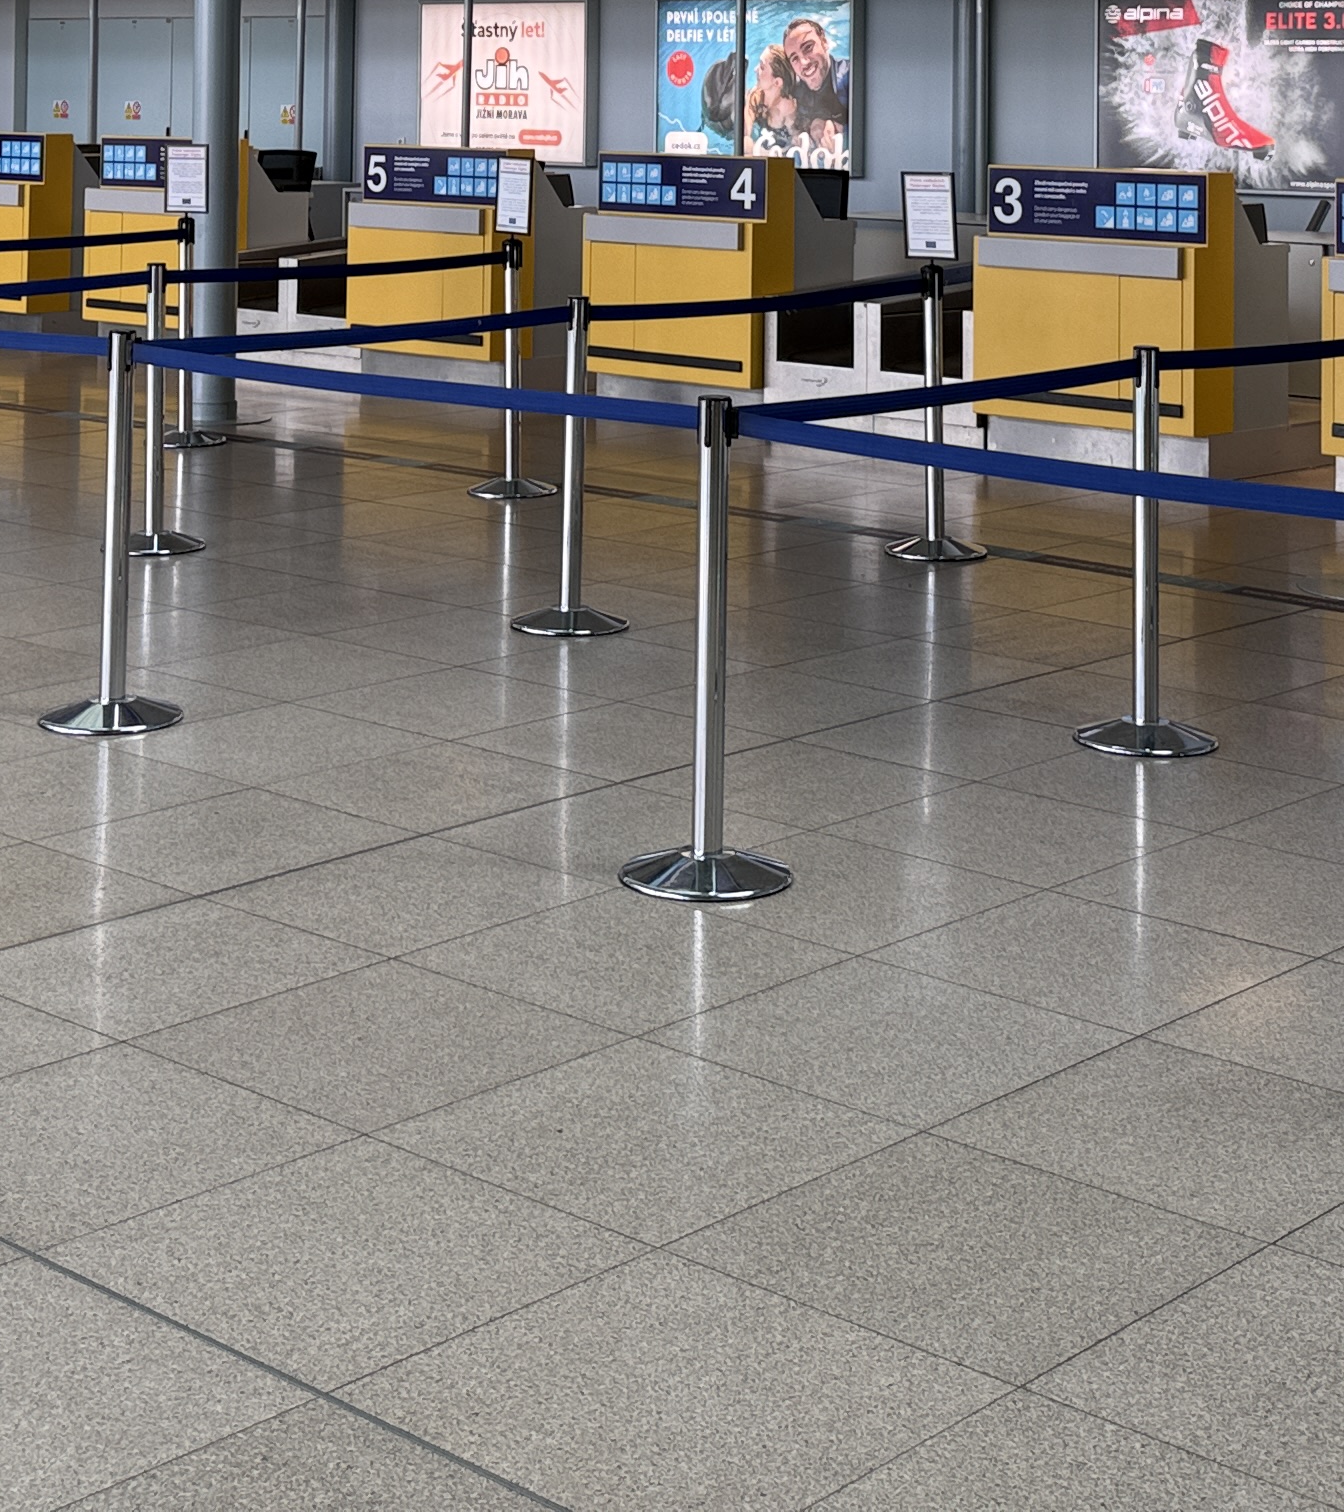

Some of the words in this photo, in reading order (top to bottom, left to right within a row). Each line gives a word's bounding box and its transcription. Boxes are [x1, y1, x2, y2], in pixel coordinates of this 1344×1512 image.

[666, 8, 698, 25] PRVNÍ
[1123, 5, 1184, 23] alpina
[1266, 12, 1317, 29] ELITE
[521, 21, 545, 38] let!
[666, 29, 703, 42] DELFIE
[706, 29, 714, 42] V
[475, 47, 529, 90] Jih
[476, 93, 528, 106] RADIO
[476, 107, 494, 119] JIŽNÍ
[496, 109, 527, 119] MORAVA
[366, 154, 388, 193] 5
[730, 167, 757, 210] 4
[993, 177, 1023, 225] 3
